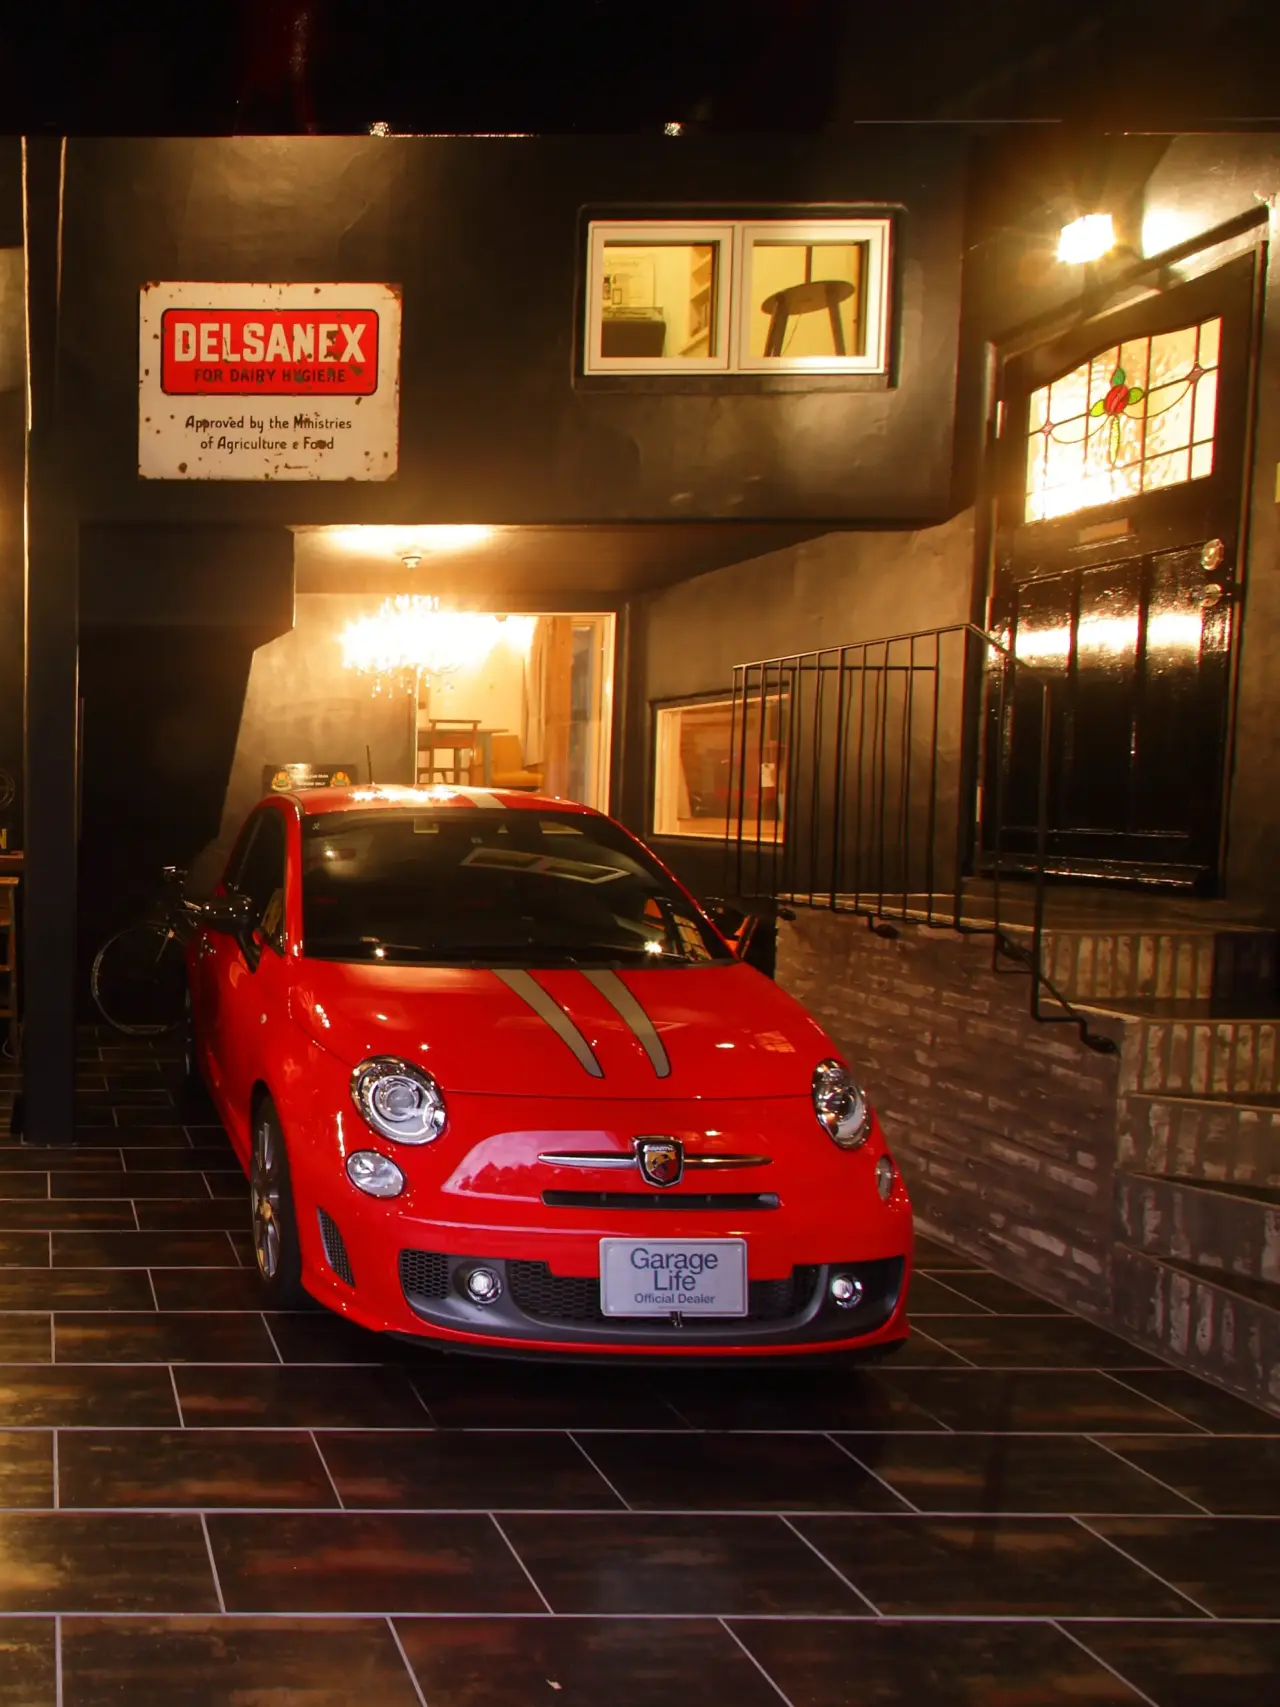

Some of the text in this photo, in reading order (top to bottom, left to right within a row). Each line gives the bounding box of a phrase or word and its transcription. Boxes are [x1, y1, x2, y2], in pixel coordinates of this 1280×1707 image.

[174, 322, 366, 363] DELSANEX
[194, 369, 346, 383] FOR DAIRY HYGIENE
[185, 414, 352, 433] Approved by the Ministries
[200, 436, 214, 450] of
[217, 436, 287, 454] Agriculture
[630, 1247, 718, 1275] Garage
[654, 1269, 696, 1291] Life
[634, 1293, 716, 1304] Official Dealer
